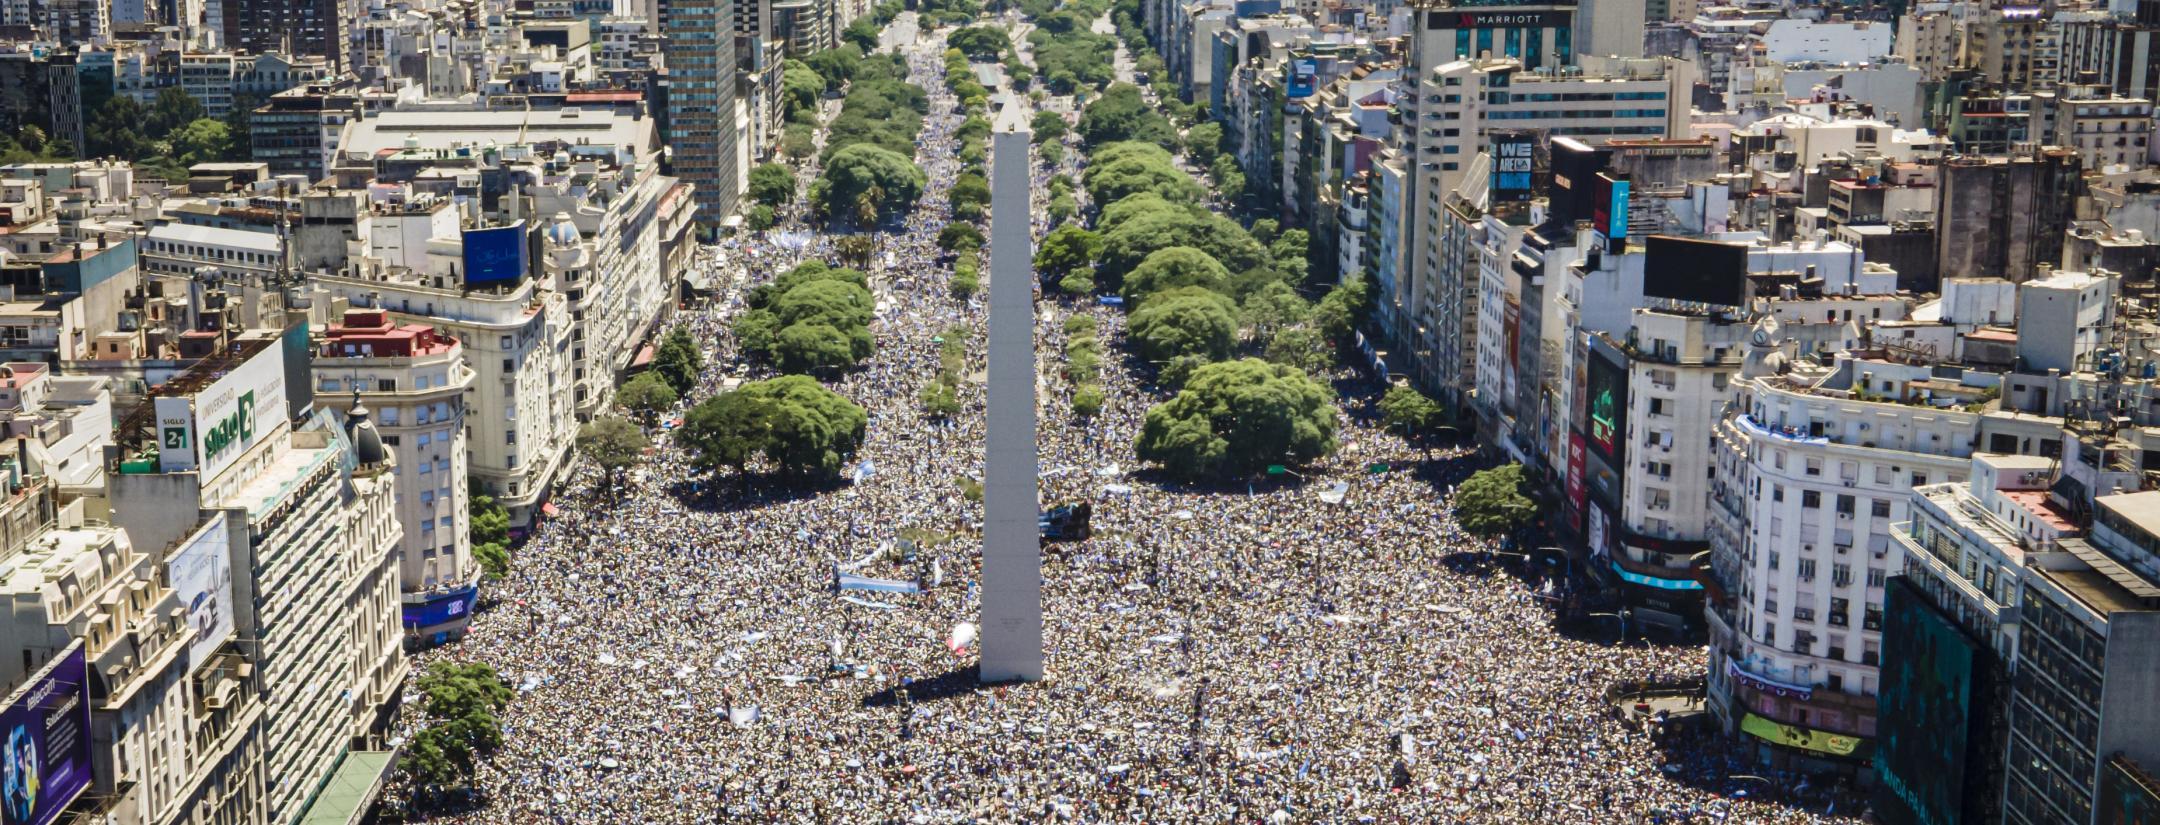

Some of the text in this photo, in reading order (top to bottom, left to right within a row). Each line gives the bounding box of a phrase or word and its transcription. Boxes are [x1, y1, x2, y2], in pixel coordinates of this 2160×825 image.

[1477, 15, 1541, 24] MARRIOTT
[1501, 143, 1531, 156] WE
[1500, 157, 1515, 172] ARE
[242, 395, 256, 440] 21
[166, 430, 186, 449] 21
[27, 677, 55, 712] telecom
